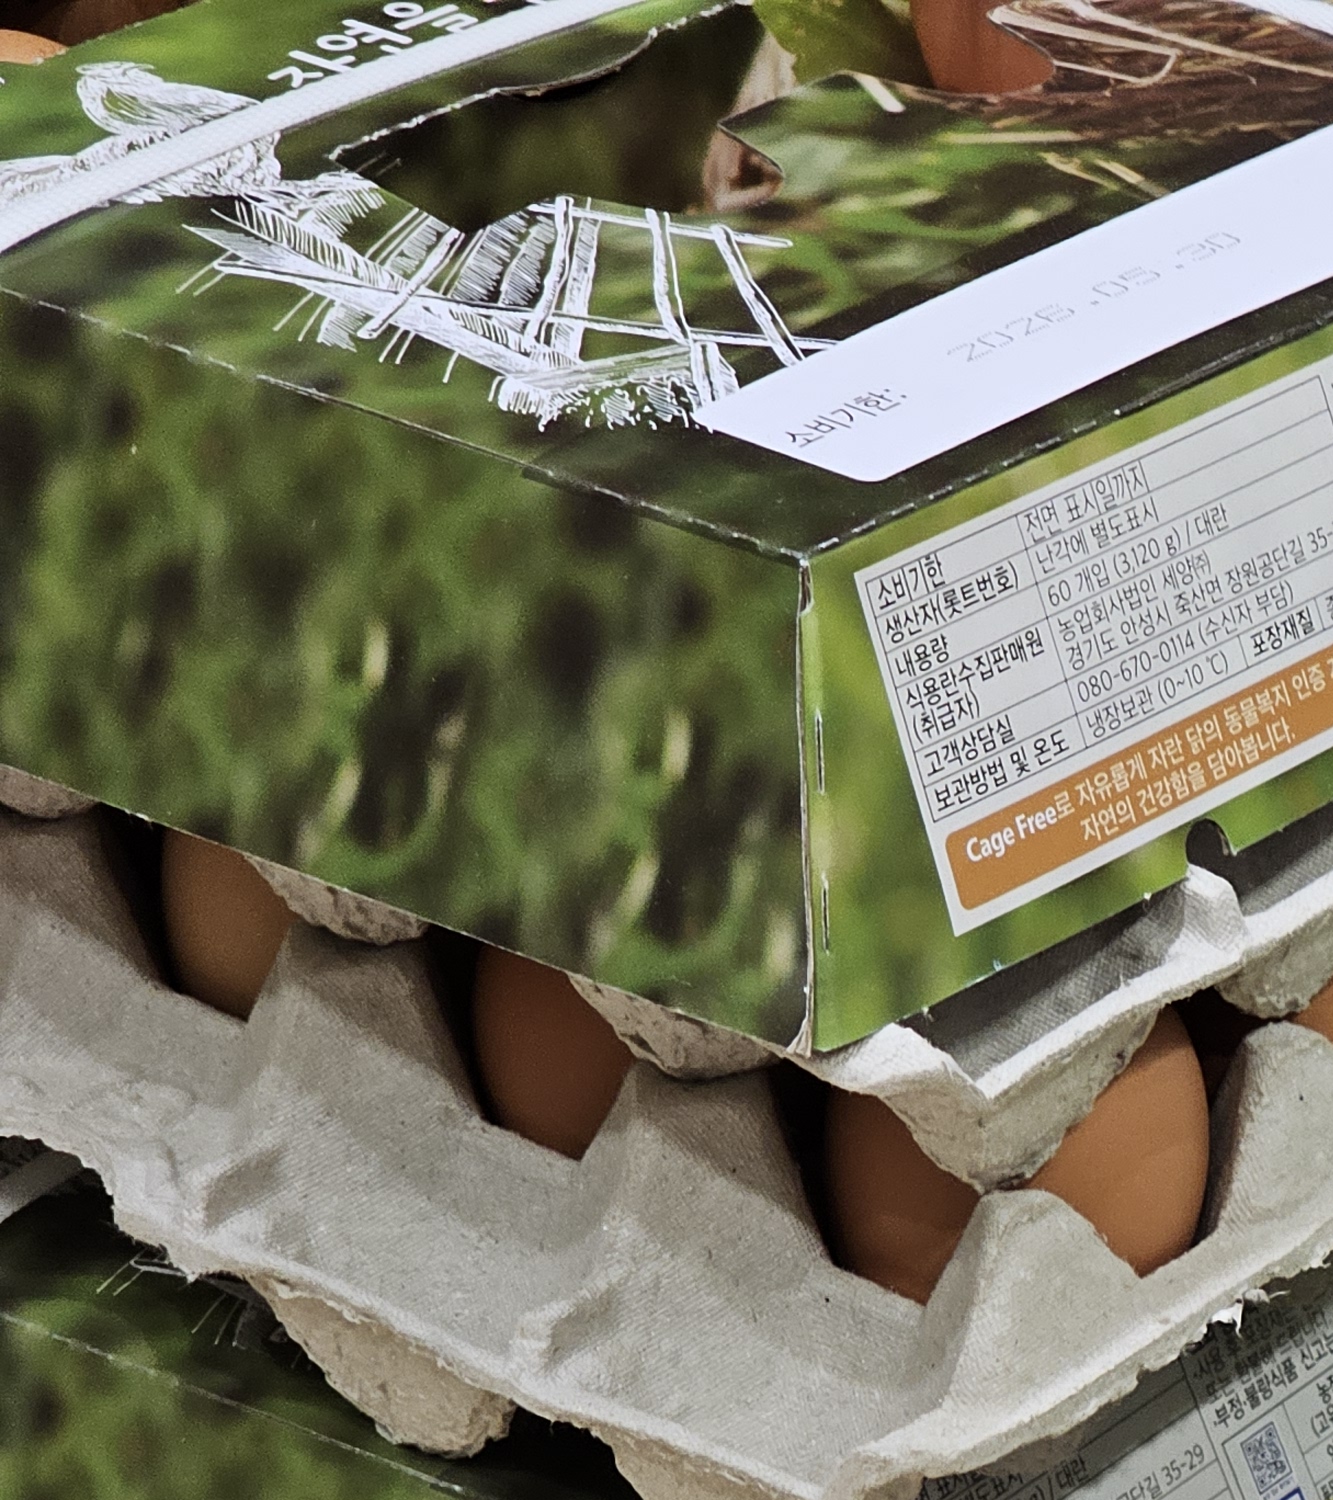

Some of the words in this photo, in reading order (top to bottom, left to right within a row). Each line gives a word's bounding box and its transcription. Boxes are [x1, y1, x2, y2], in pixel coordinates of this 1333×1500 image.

[1023, 499, 1063, 545] 전면
[1063, 459, 1148, 525] 표시일까지
[1034, 527, 1090, 575] 난각에
[1089, 495, 1160, 550] 별도표시
[877, 552, 947, 611] 소비기한
[1047, 578, 1073, 608] 60
[1073, 558, 1111, 593] 개입
[1112, 536, 1162, 579] (3,120
[1164, 526, 1182, 558] g)
[1193, 502, 1230, 536] 대란
[885, 560, 1019, 645] 생산자(롯트번호)
[1056, 572, 1160, 643] 농업회사법인
[1065, 627, 1120, 672] 경기도
[1119, 599, 1174, 646] 안성시
[1172, 574, 1225, 618] 죽산면
[1224, 535, 1307, 596] 장원공단길
[1076, 628, 1196, 704] 080-670-0114
[1197, 598, 1254, 647] (수신자
[1254, 579, 1295, 617] 부담)
[1249, 605, 1316, 658] 포장재질
[894, 633, 950, 678] 내용량
[905, 626, 1046, 711] 식용란수집판매원
[912, 688, 981, 745] (취급자)
[923, 713, 1016, 778] 고객상담실
[1085, 685, 1156, 739] 냉장보관
[933, 756, 1009, 813] 보관방법
[1009, 745, 1031, 778] 및
[1032, 728, 1070, 767] 온도
[965, 826, 1016, 863] Cage
[1014, 790, 1076, 840] Free로
[1073, 751, 1149, 807] 자유롭게
[1146, 732, 1186, 770] 자란
[1184, 713, 1224, 756] 닭의
[1222, 679, 1292, 736] 동물복지
[1291, 662, 1327, 701] 인증
[1079, 794, 1137, 842] 자연의
[1135, 760, 1207, 817] 건강함을
[1206, 715, 1296, 781] 담아봅니다.
[1160, 1442, 1205, 1487] 35-29
